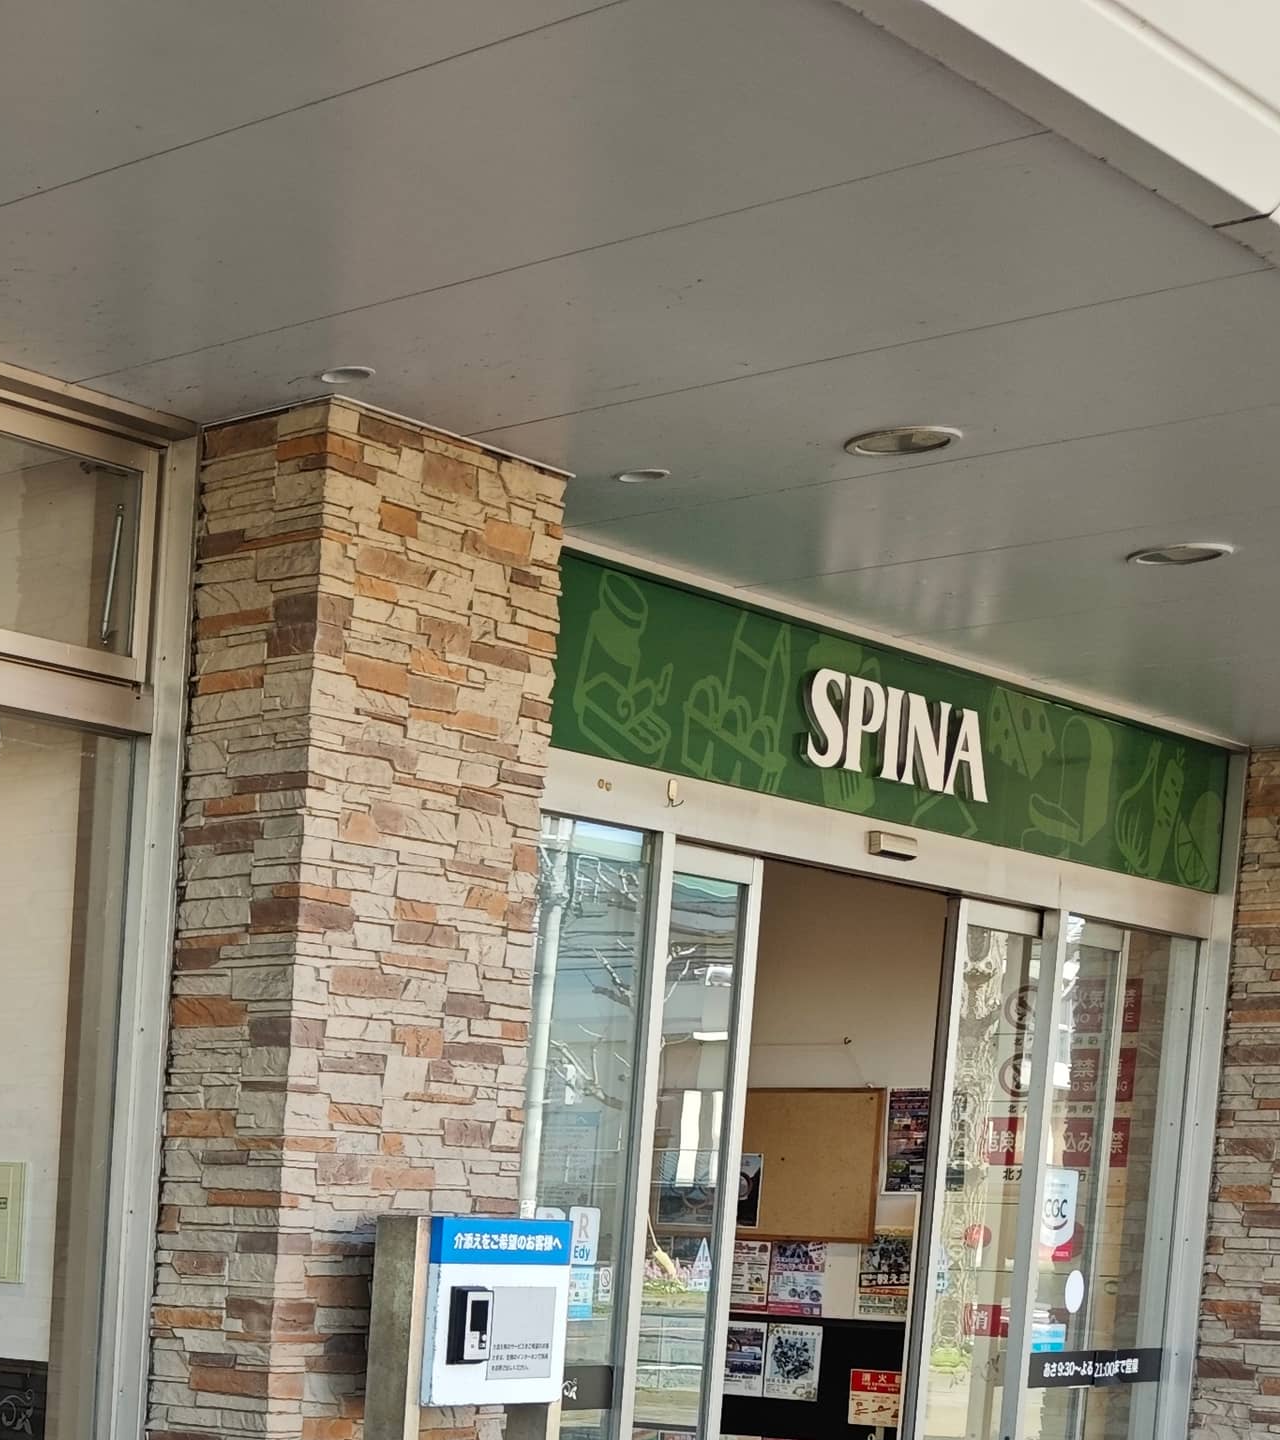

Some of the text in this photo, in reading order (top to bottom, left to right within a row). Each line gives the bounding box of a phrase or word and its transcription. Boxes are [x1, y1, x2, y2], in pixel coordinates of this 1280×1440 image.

[807, 667, 989, 804] SPINA
[1043, 1198, 1068, 1219] CGC
[453, 1232, 563, 1252] 介添えをご希望のお客様へ
[573, 1245, 591, 1261] Edy
